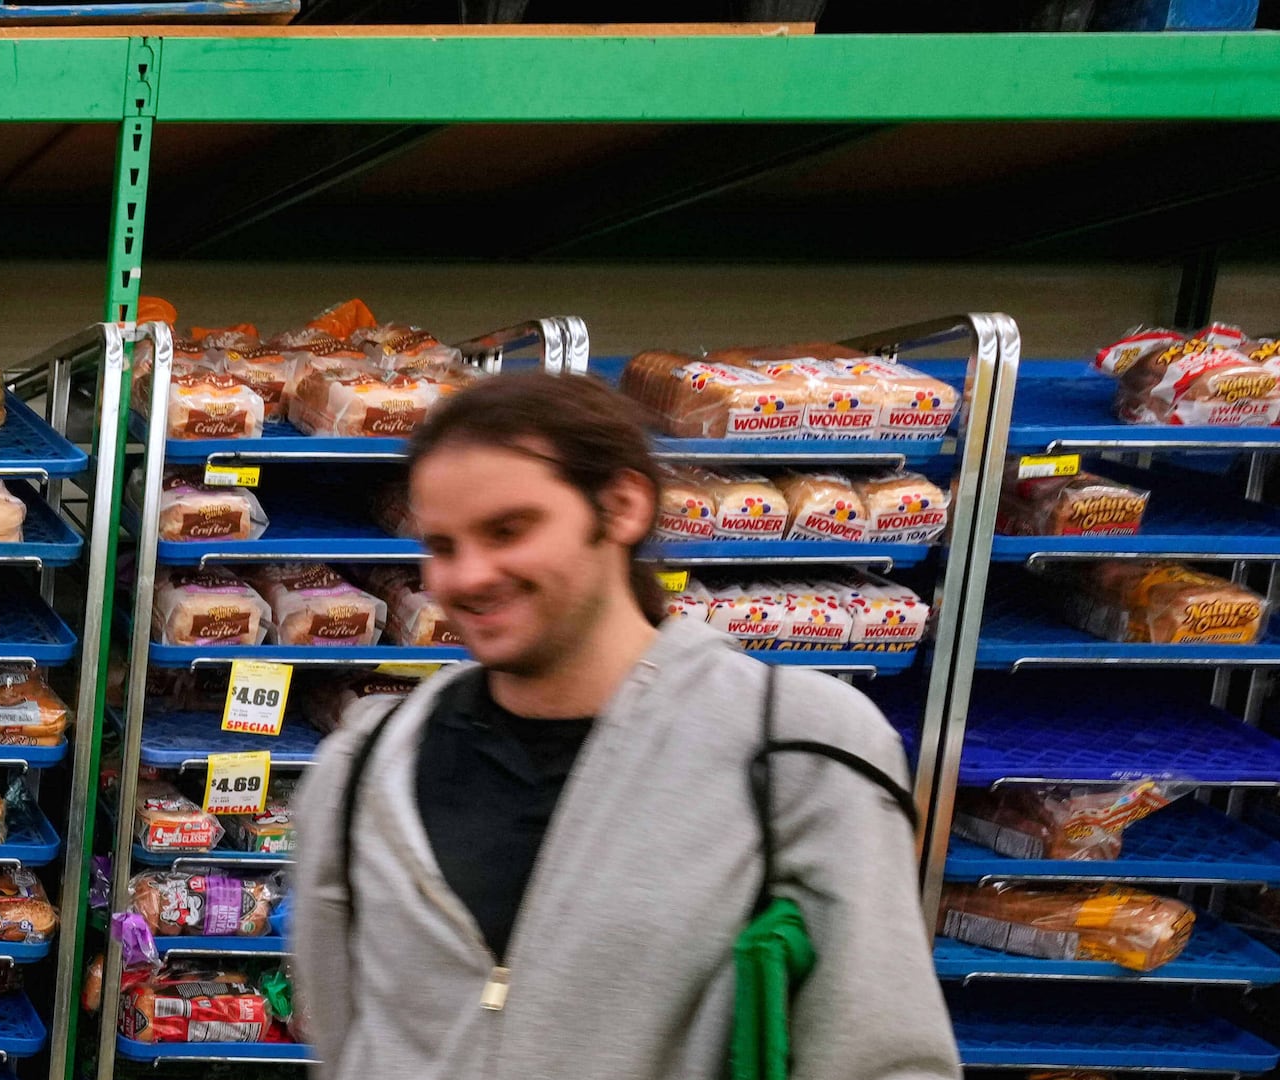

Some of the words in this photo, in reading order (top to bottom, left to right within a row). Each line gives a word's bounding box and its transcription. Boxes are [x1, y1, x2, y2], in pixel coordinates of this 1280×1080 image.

[734, 414, 799, 431] WONDER
[808, 414, 873, 427] WONDER
[889, 413, 951, 427] WONDER
[194, 421, 237, 436] Crafted
[721, 517, 783, 531] WONDER
[805, 515, 863, 540] WONDER
[877, 513, 944, 529] WONDER
[190, 524, 233, 537] Crafted
[199, 625, 242, 638] Crafted
[317, 625, 358, 638] Crafted
[728, 621, 779, 634] WONDER
[792, 624, 844, 637] WONDER
[865, 626, 917, 638] WONDER
[231, 686, 280, 708] $4.69
[226, 720, 276, 734] SPECIAL
[211, 776, 261, 793] $4.69
[207, 805, 260, 814] SPECIAL
